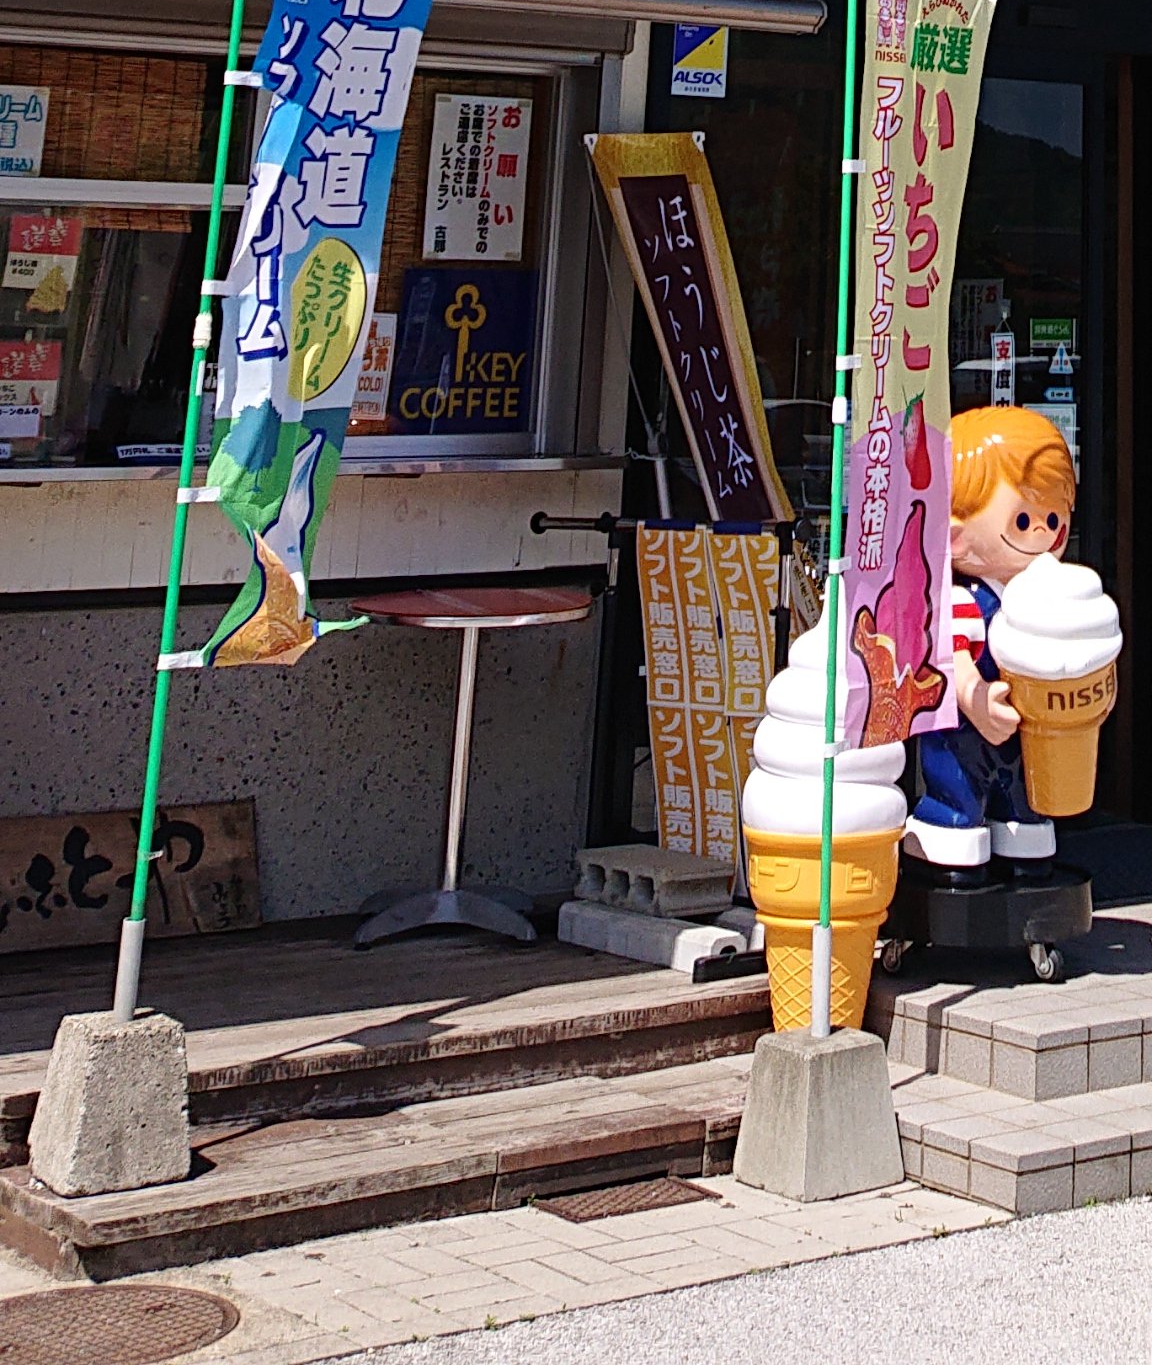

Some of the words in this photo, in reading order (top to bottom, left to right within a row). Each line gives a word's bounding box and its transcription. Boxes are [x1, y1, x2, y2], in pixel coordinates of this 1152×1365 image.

[673, 70, 723, 86] ALSOK
[910, 21, 974, 75] 厳選
[437, 143, 453, 211] レストラン
[475, 105, 499, 253] ソフトクリームのみでの
[903, 80, 954, 372] いちご
[305, 260, 355, 391] 生クリーム
[466, 352, 528, 383] KEY
[645, 234, 733, 499] ソフトクリーム
[658, 195, 754, 489] ほうじ茶
[858, 75, 904, 571] フルーツソフトクリームの本格派
[400, 387, 520, 419] COFFEE
[643, 530, 681, 701] ソフト販売窓口
[672, 530, 721, 704] ソフト販売窓口
[714, 538, 762, 710] ソフト販売窓口
[655, 710, 693, 853] ソフト販売窓
[696, 714, 734, 862] ソフト販売窓
